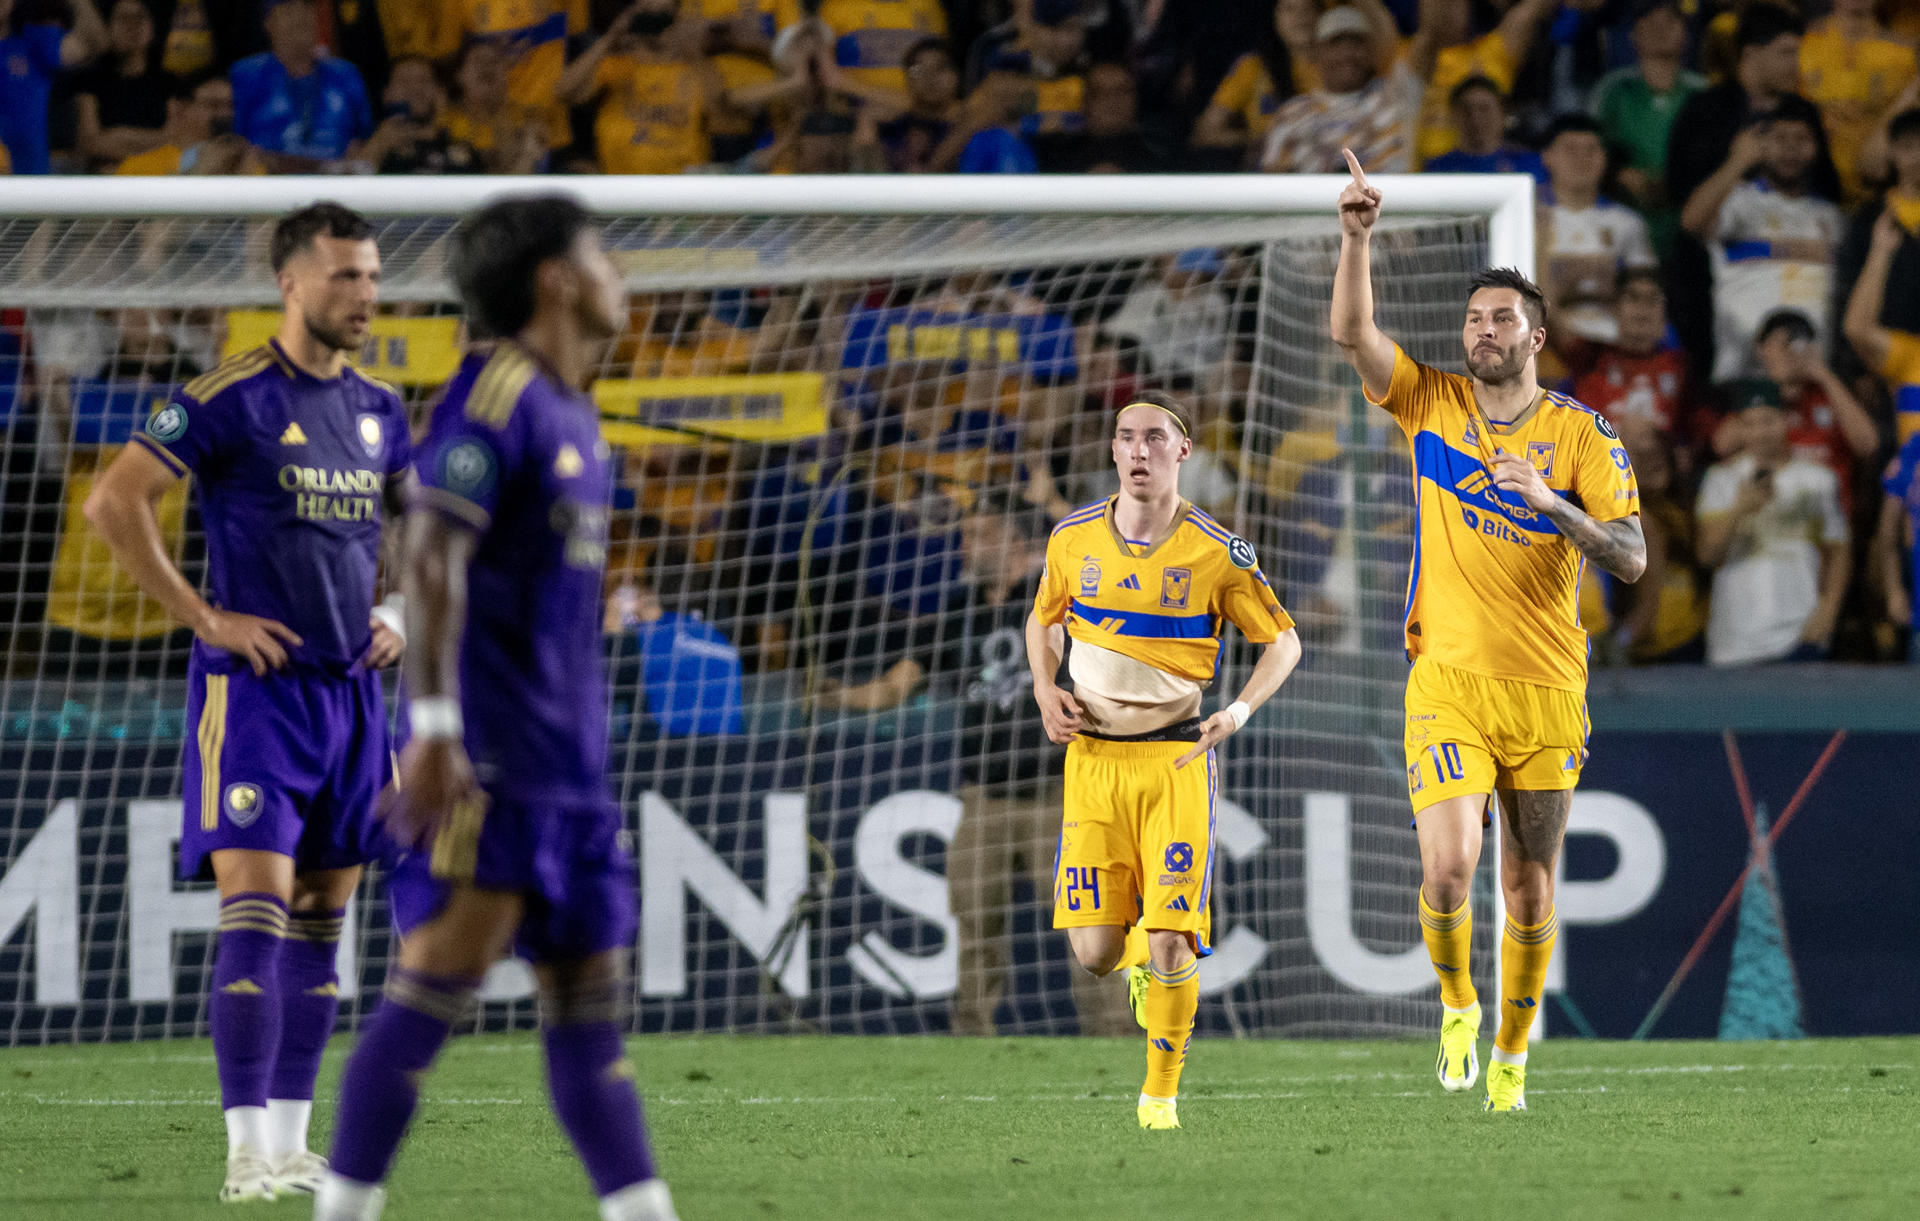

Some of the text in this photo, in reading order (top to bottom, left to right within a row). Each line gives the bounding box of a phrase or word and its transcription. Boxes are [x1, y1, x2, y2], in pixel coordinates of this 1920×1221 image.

[1483, 519, 1531, 547] Bitso
[1427, 742, 1465, 783] 10
[1066, 867, 1100, 910] 24
